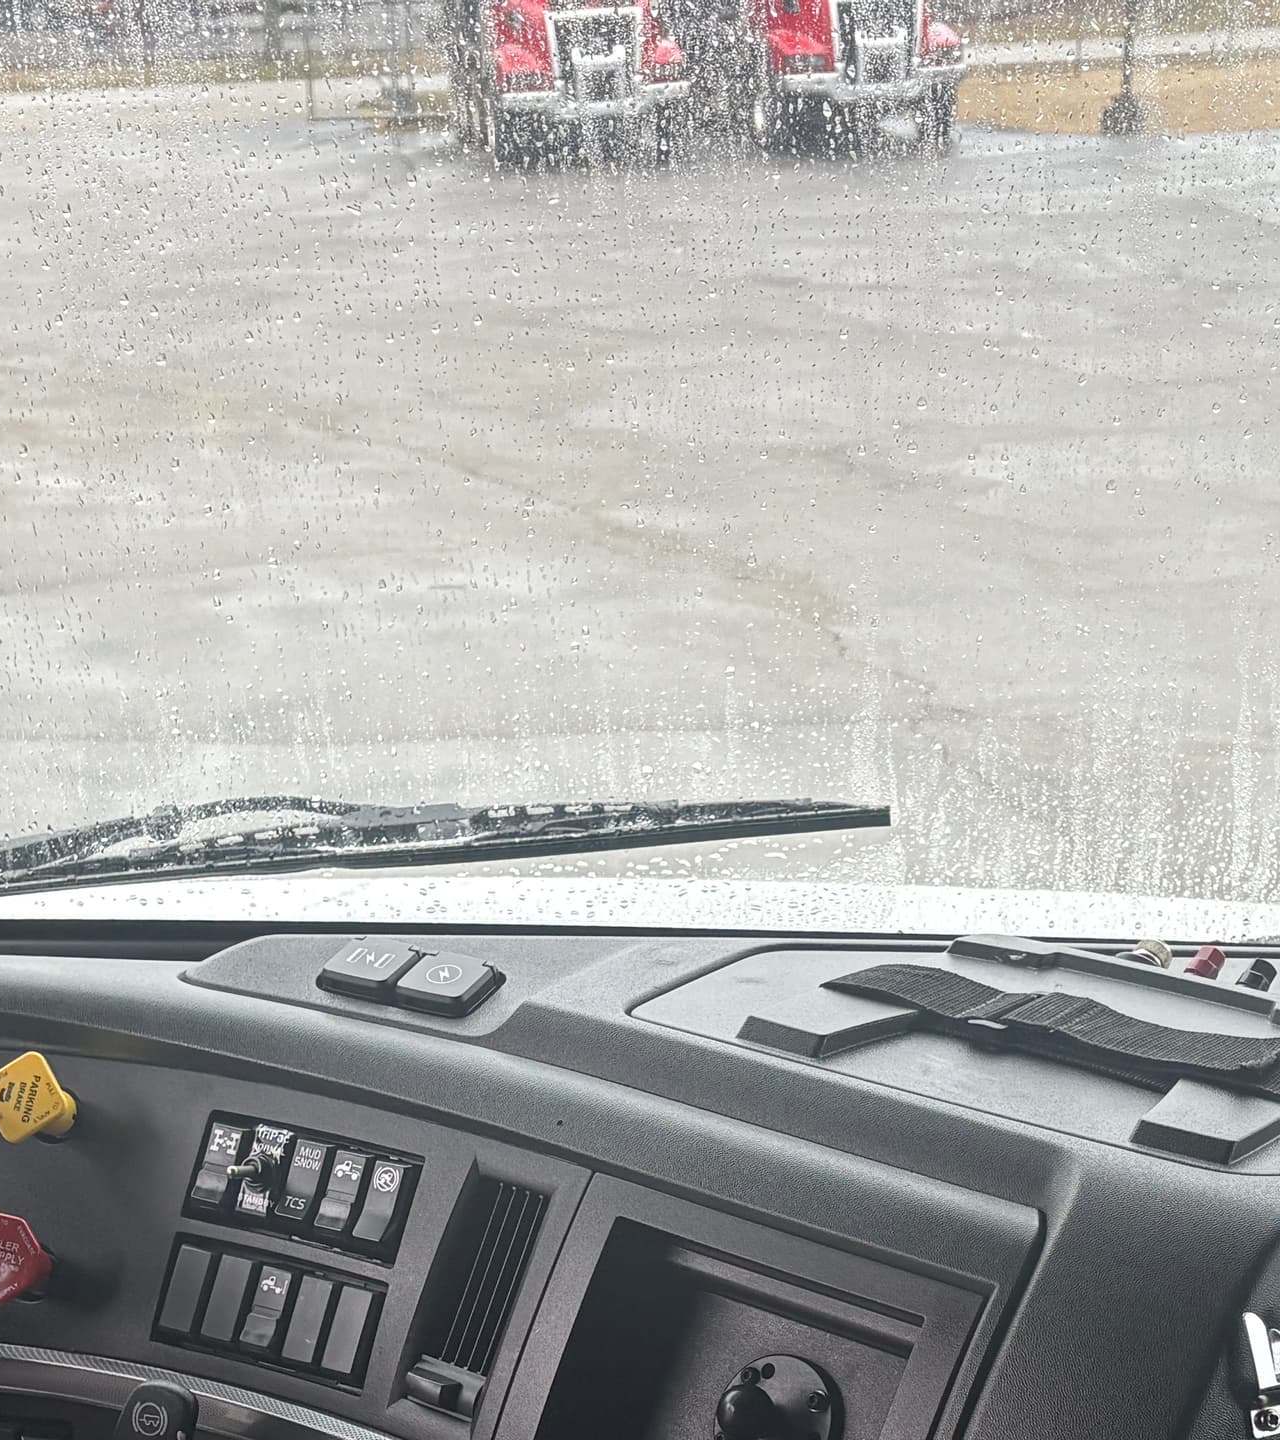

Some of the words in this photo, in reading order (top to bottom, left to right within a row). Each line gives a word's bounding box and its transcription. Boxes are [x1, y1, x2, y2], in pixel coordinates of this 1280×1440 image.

[21, 1074, 42, 1123] PARKING
[299, 1146, 322, 1160] MUD
[293, 1155, 322, 1172] SNOW
[283, 1195, 307, 1211] TCS
